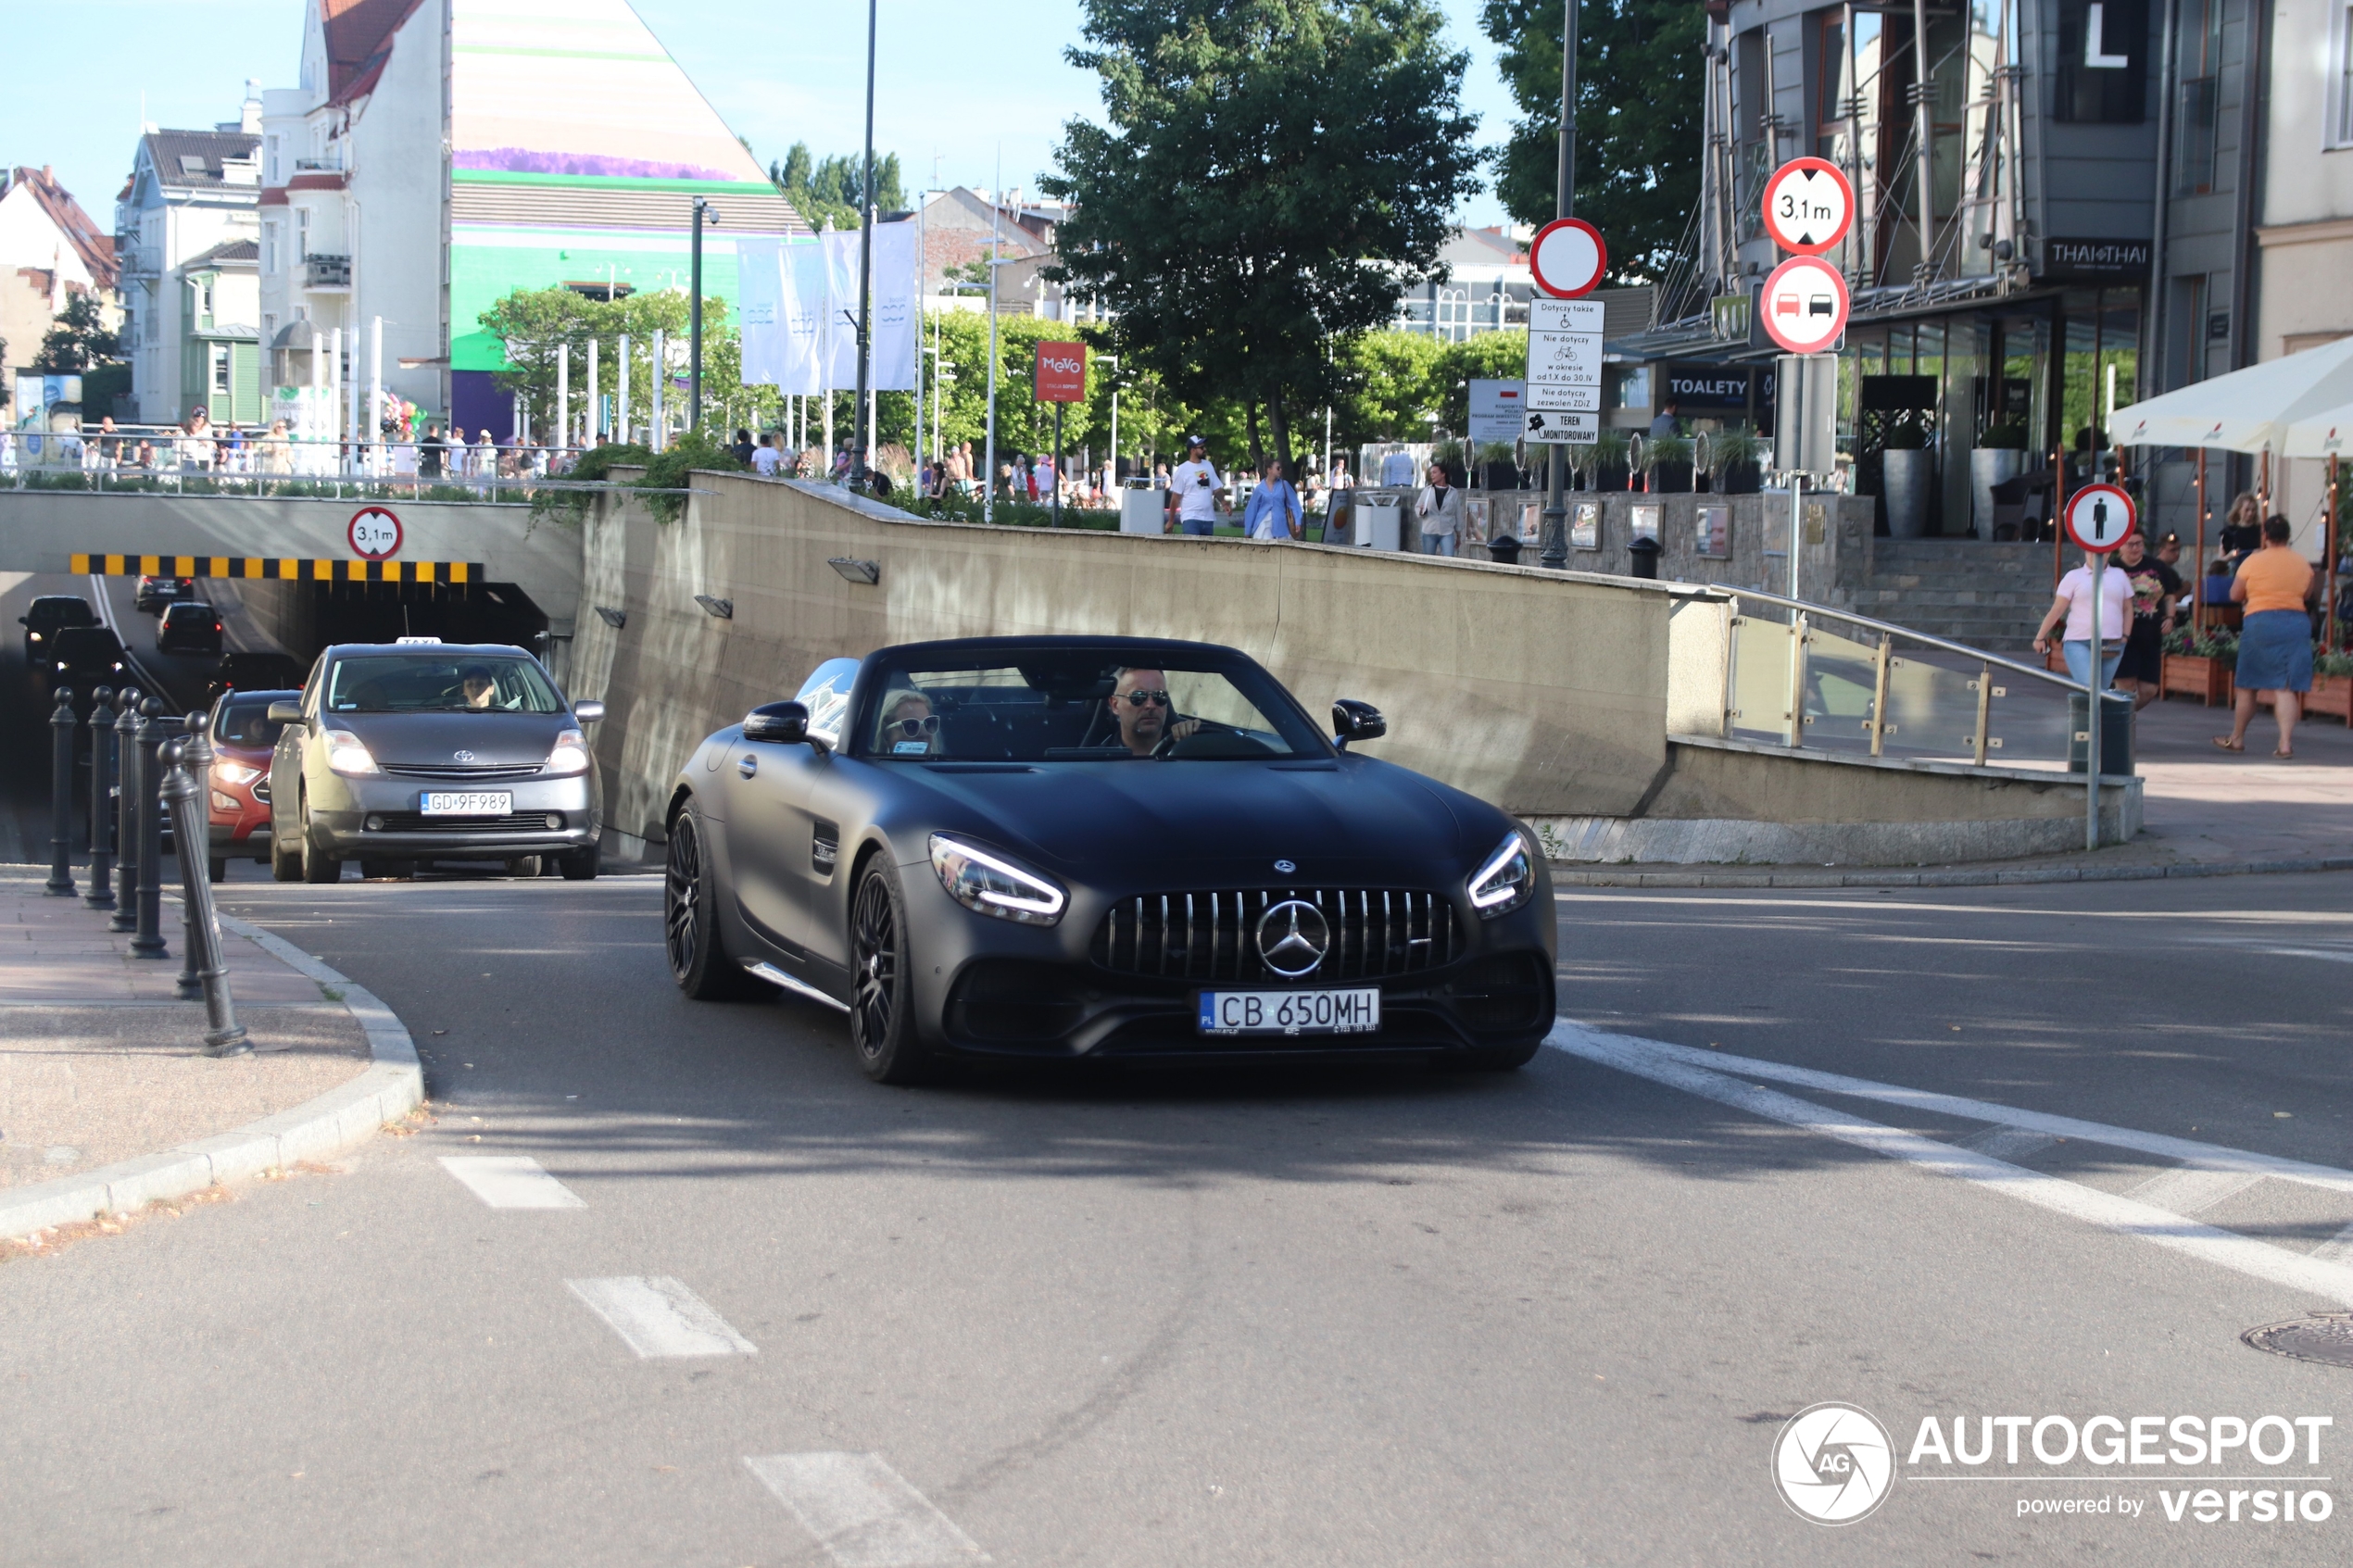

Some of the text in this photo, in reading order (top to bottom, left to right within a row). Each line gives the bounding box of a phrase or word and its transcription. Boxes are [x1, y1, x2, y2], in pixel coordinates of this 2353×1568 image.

[2052, 244, 2146, 264] THAI THAI
[1541, 304, 1594, 313] Dotyczy także
[1560, 334, 1590, 345] dotyczy
[1670, 379, 1747, 395] TOALETY
[1557, 389, 1586, 398] dotyczy
[1560, 416, 1581, 426] TEREN
[1543, 430, 1596, 441] MONITOROWANY
[432, 795, 452, 809] GD
[459, 794, 507, 809] 9F989
[1202, 993, 1371, 1027] PL CB 650MH
